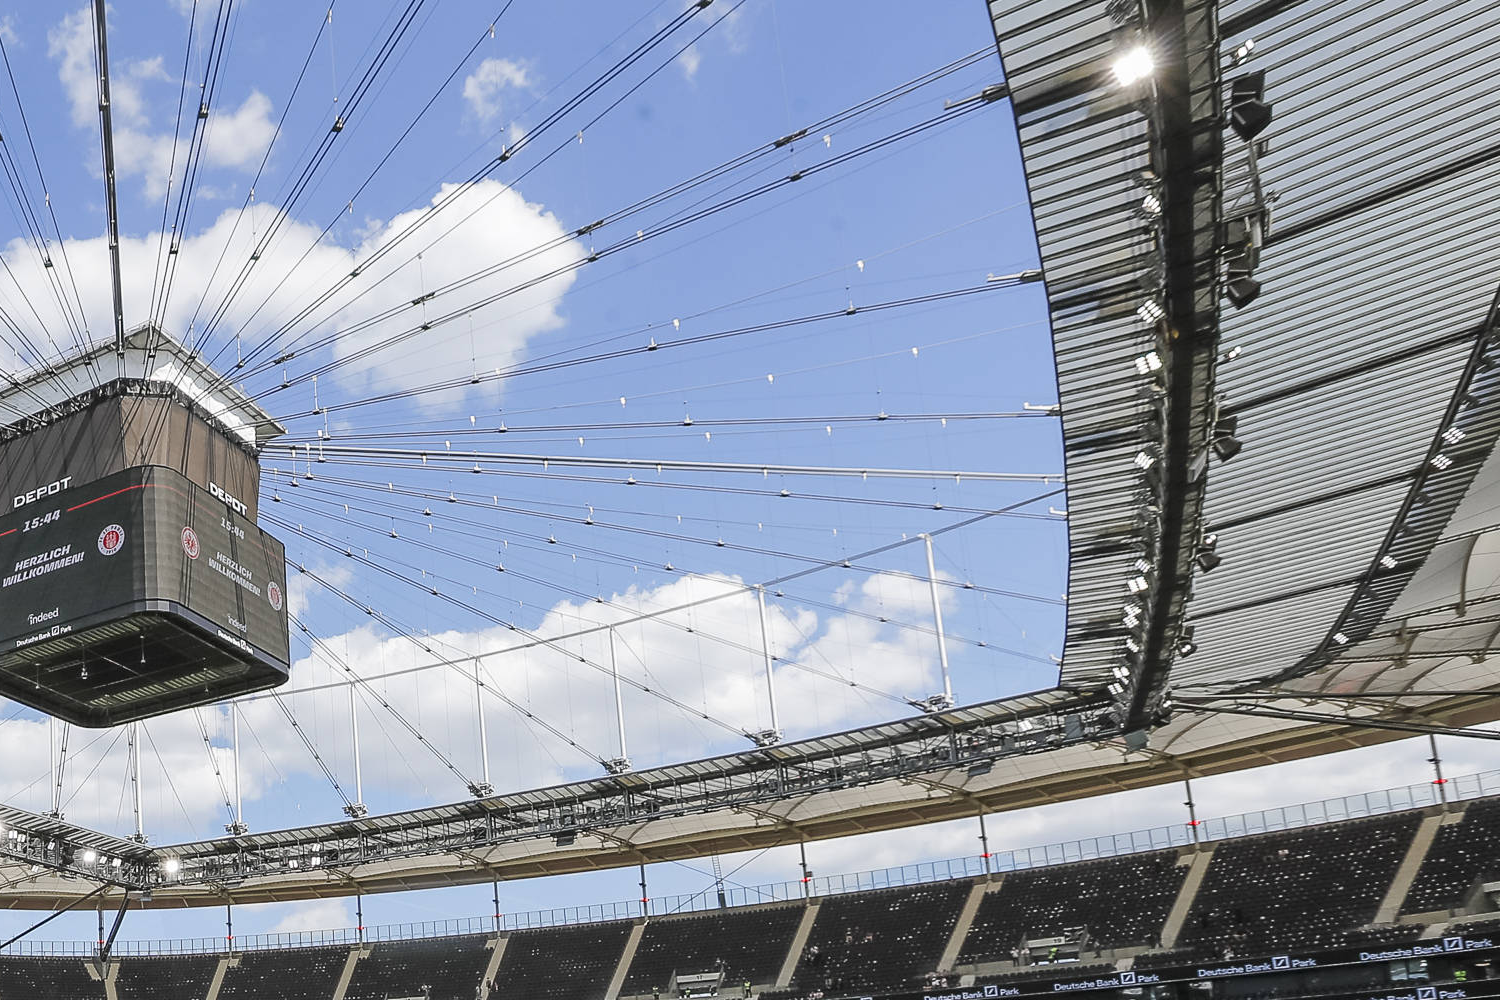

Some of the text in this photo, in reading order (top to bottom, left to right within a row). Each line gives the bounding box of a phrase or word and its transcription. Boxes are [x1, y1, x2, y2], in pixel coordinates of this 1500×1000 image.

[14, 476, 72, 508] DEPOT
[209, 482, 248, 516] DEPOT
[22, 509, 61, 533] 15:44
[221, 517, 245, 540] 15:44
[2, 552, 85, 587] WILLKOMMEN!
[15, 544, 71, 572] HERZLICH
[216, 552, 252, 580] HERZLICH
[208, 557, 261, 597] WILLKOMMEN!
[28, 608, 59, 625] indeed
[16, 625, 72, 648] Deutsche Bank Park
[1360, 939, 1492, 961] Deutsche Bank Park
[1198, 958, 1316, 977] Deutsche Bank Park
[963, 991, 983, 999] Bank
[1000, 987, 1020, 996] Park
[1054, 974, 1159, 991] Deutsche Bank Park
[1439, 989, 1466, 1000] Park
